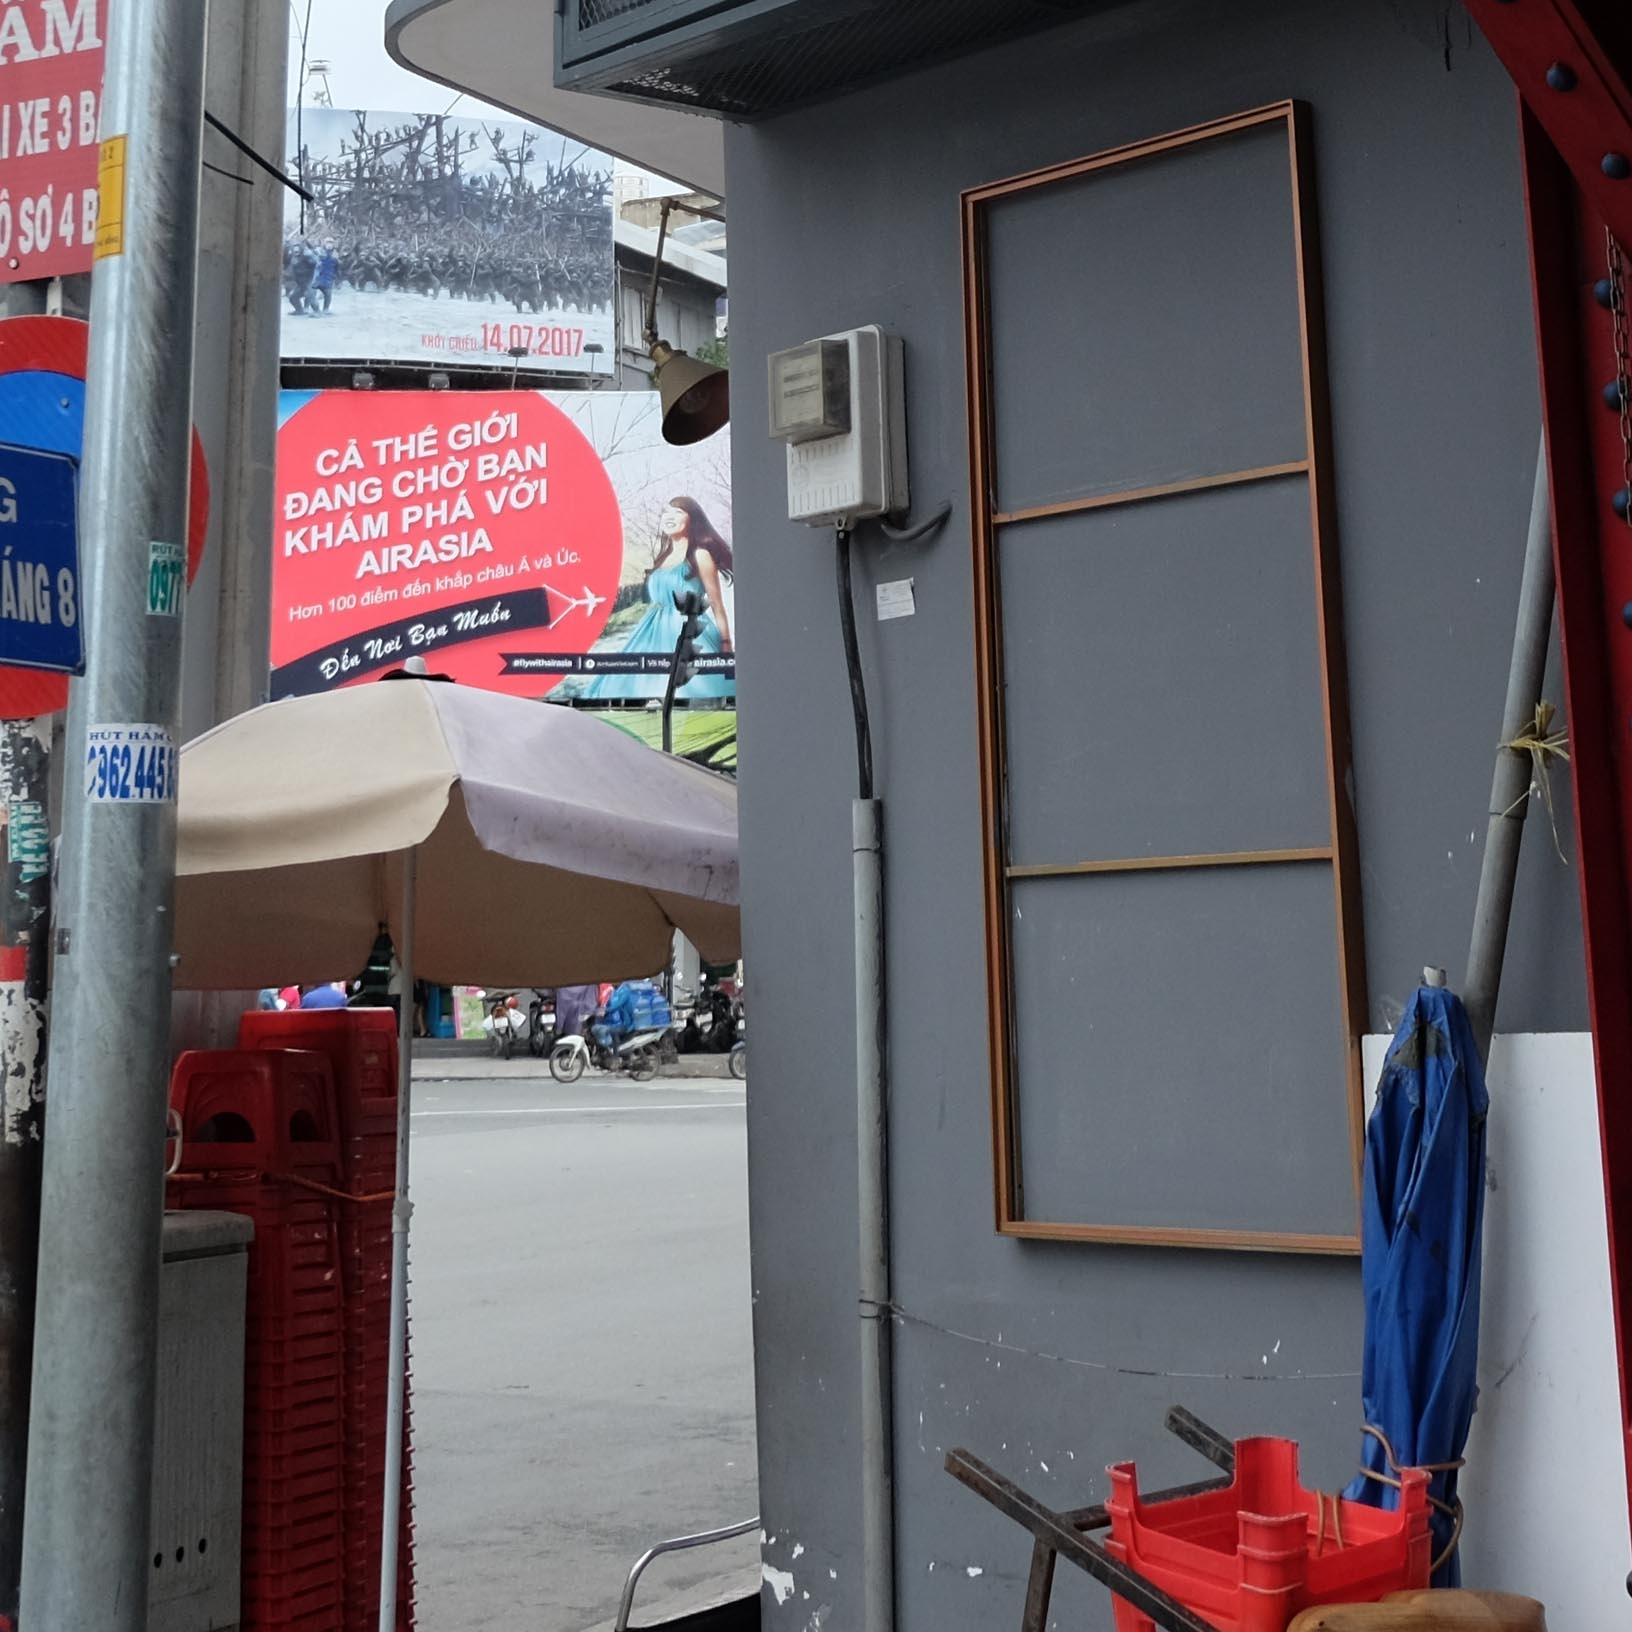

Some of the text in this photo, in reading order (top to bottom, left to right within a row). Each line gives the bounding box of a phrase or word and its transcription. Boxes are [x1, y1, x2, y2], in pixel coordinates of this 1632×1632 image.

[16, 97, 51, 157] XE
[57, 95, 72, 151] 3
[79, 74, 104, 146] B
[19, 184, 54, 255] SƠ
[59, 192, 74, 247] 4
[481, 323, 584, 358] 14.07.2017
[316, 411, 519, 478] CẢ THẾ GIỚI
[283, 442, 548, 521] ĐANG CHỜ BẠN
[283, 475, 549, 557] KHÁM PHÁ VỚI
[289, 600, 324, 622] Hơn
[328, 591, 357, 615] 100
[360, 579, 399, 608] điểm
[402, 575, 432, 602] đến
[476, 560, 514, 588] châu
[517, 549, 531, 574] Á
[533, 551, 553, 571] và
[355, 526, 492, 580] AIRASIA
[57, 566, 78, 628] 8
[320, 603, 512, 681] Đến Nơi Bạn Muốn
